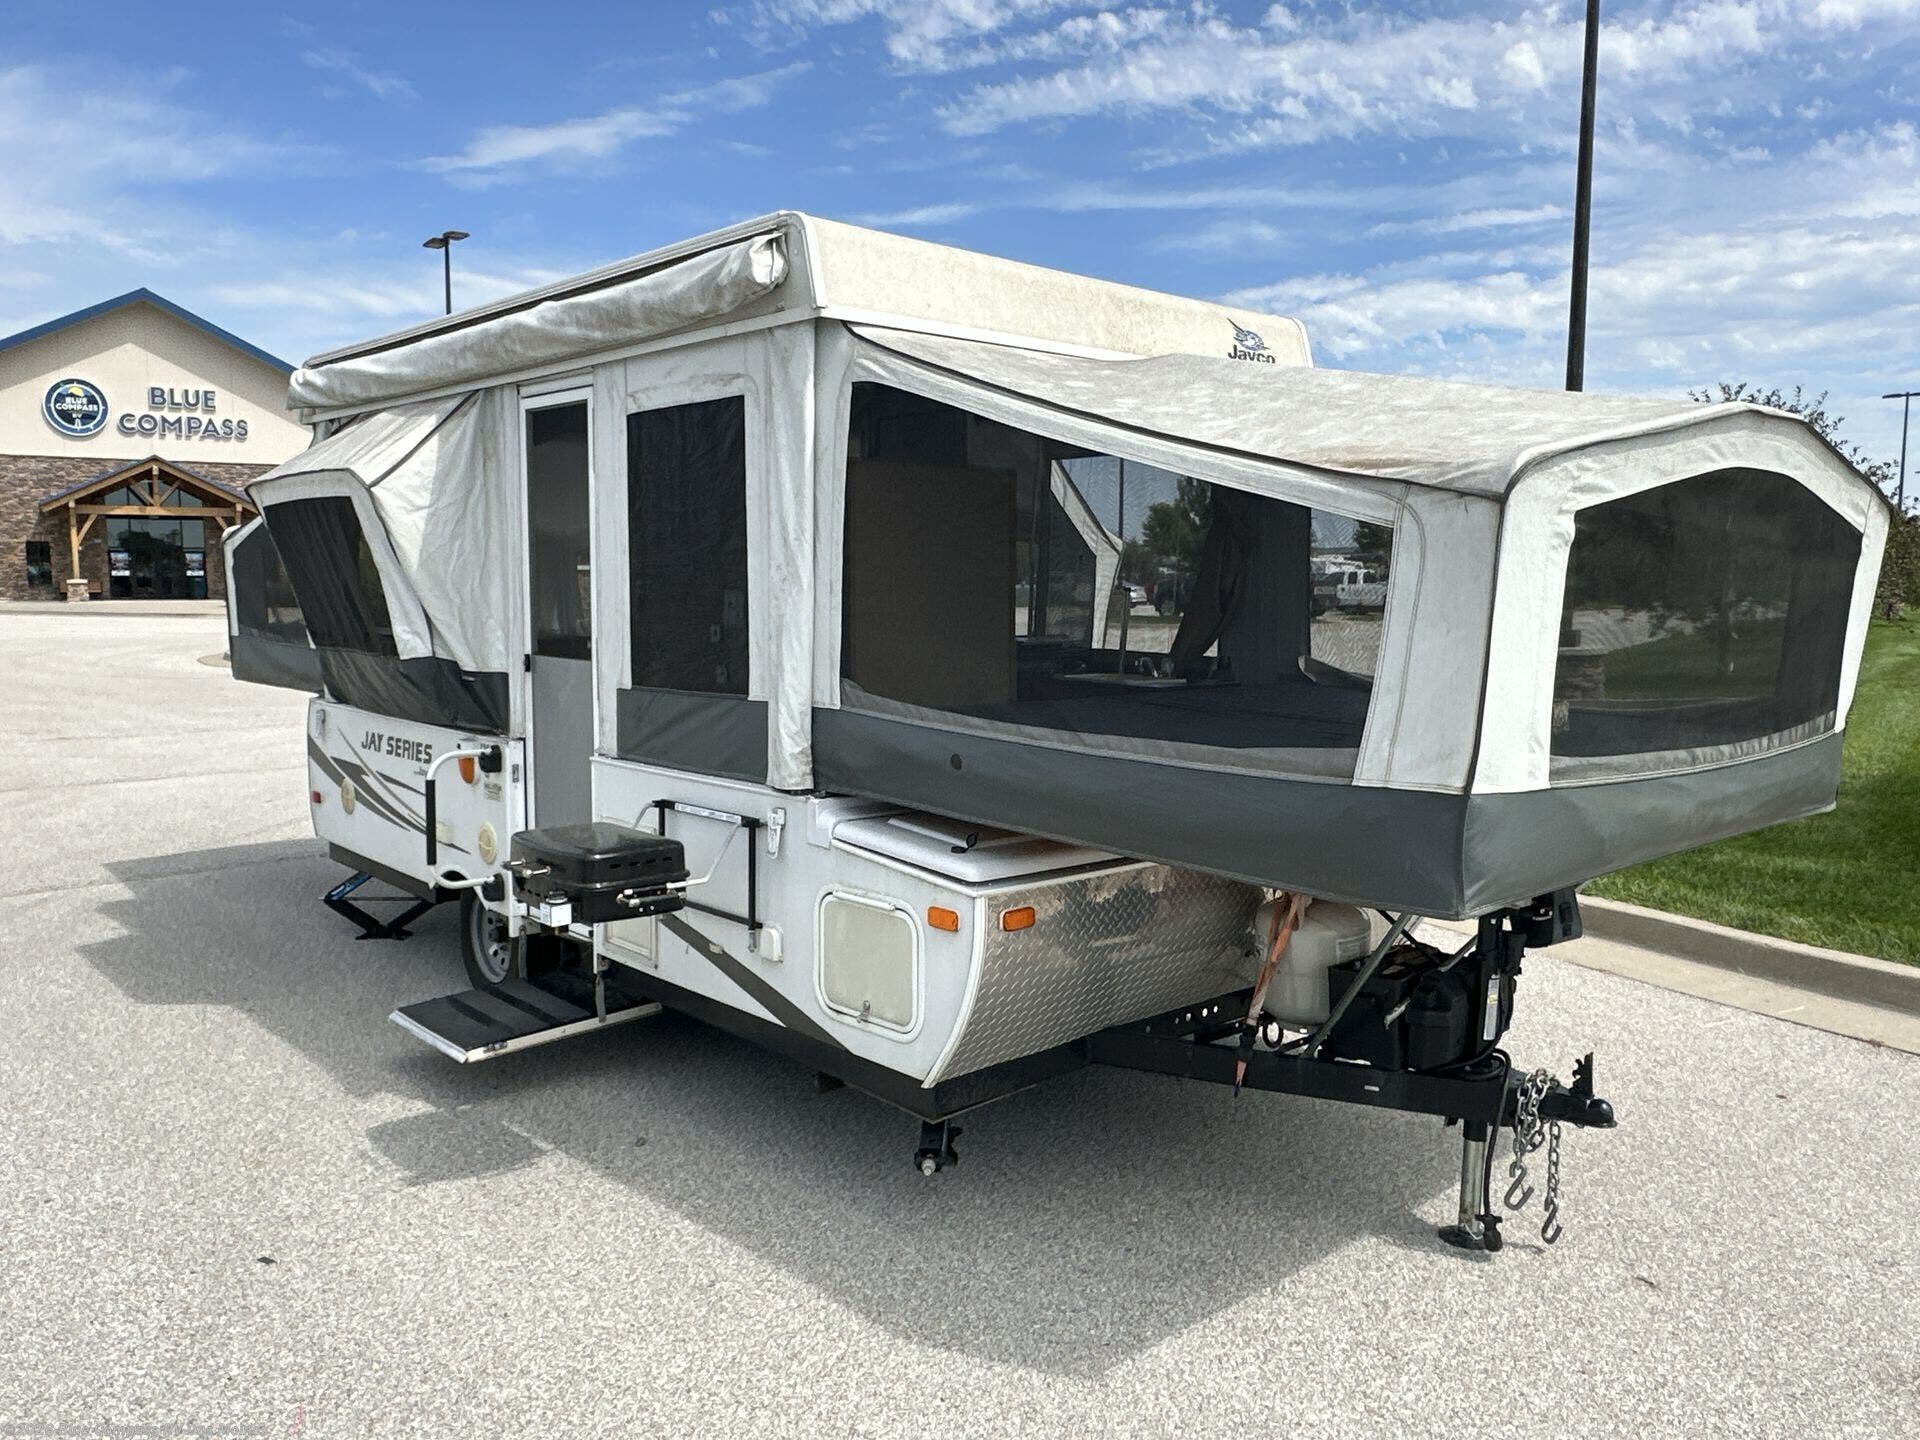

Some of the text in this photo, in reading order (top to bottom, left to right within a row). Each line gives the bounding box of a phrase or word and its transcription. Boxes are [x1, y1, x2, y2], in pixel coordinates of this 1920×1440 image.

[55, 403, 98, 411] COMPASS
[148, 386, 216, 411] BLUE
[118, 413, 248, 438] COMPASS
[361, 730, 432, 764] JAY SERIES
